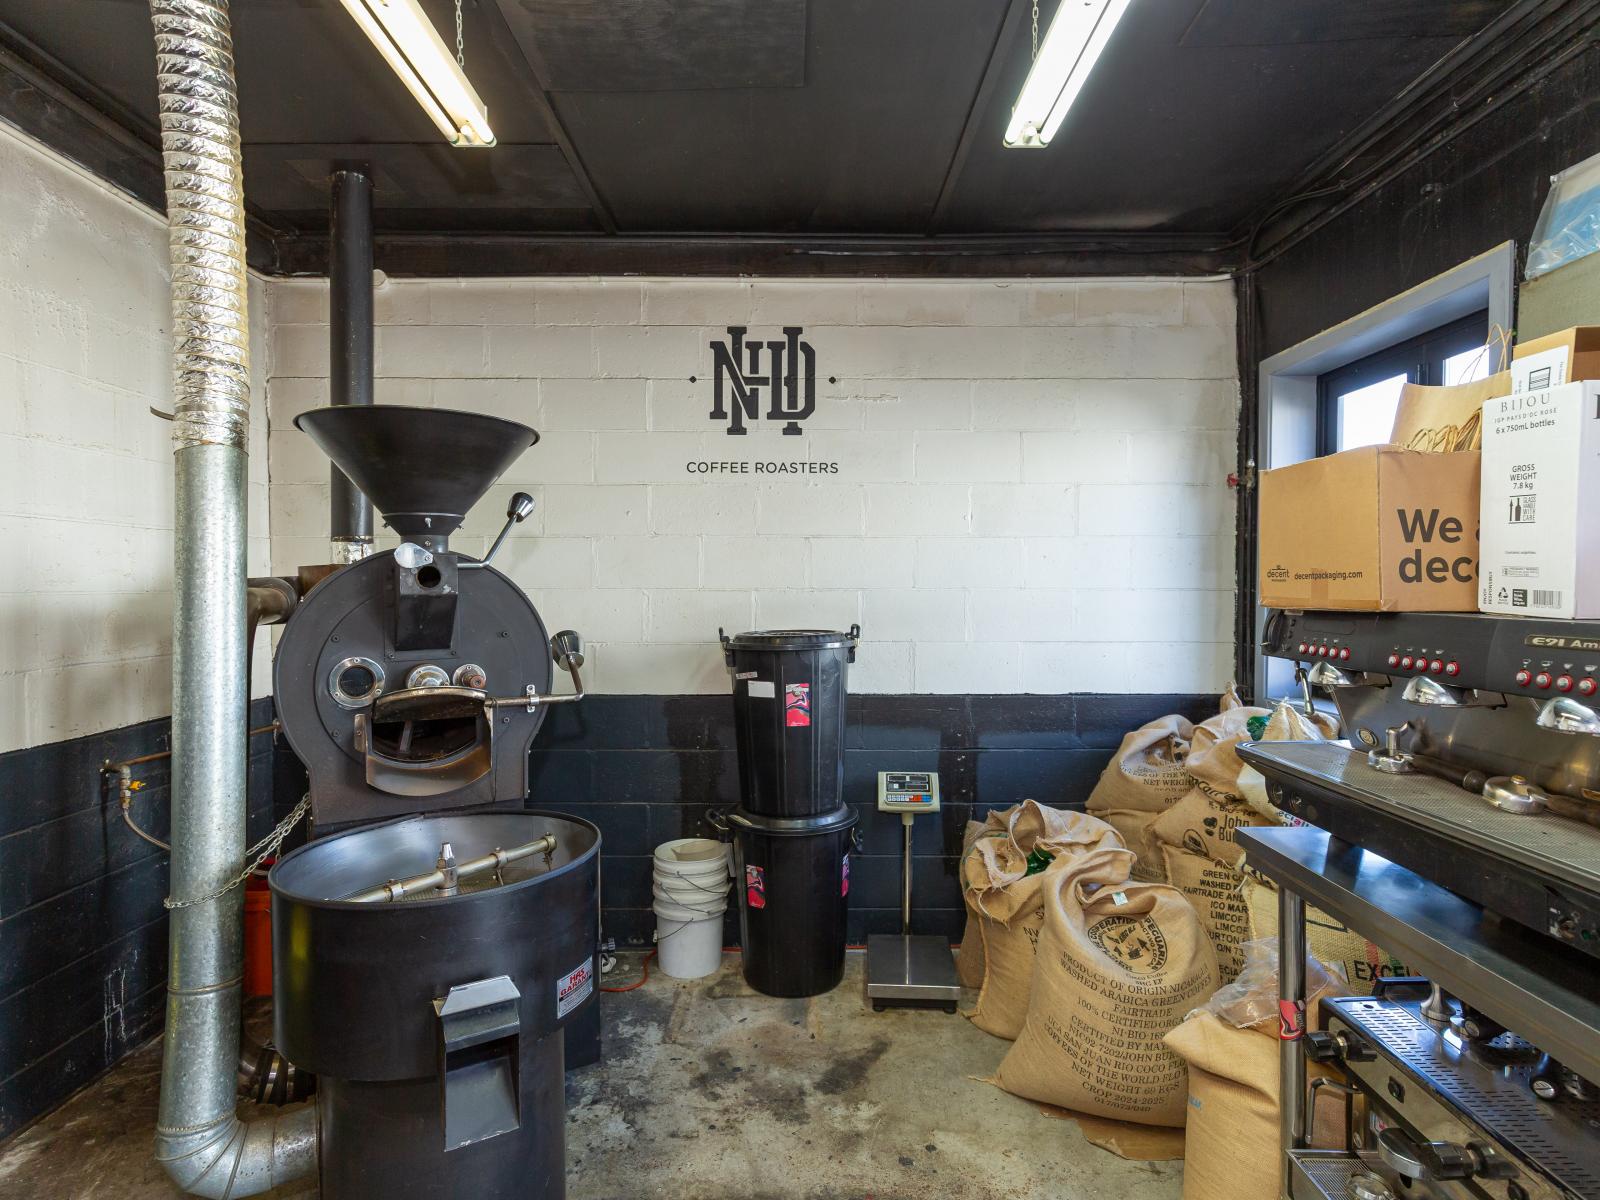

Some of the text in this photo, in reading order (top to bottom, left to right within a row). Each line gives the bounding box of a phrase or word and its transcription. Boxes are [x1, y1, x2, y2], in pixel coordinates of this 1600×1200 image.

[1501, 392, 1550, 413] BIJOU
[1495, 426, 1501, 434] 6
[1506, 422, 1528, 433] 750mL
[1530, 419, 1555, 429] bottles
[686, 461, 839, 474] COFFEE ROASTERS
[1512, 463, 1535, 473] GROSS
[1510, 471, 1537, 481] WEIGHT
[1513, 481, 1534, 491] 7.8 kg
[1396, 508, 1464, 543] We
[1266, 568, 1290, 578] decent
[1398, 548, 1480, 584] dec
[1294, 570, 1363, 581] decentpackaging.com
[1570, 639, 1600, 649] Am
[1143, 778, 1160, 786] NET
[1223, 814, 1250, 830] John
[1202, 869, 1230, 881] GREEN
[1200, 879, 1232, 891] WASHED
[1183, 886, 1224, 900] FAIRTRADE
[1210, 901, 1225, 910] ICO
[1210, 910, 1244, 922] LIMCOF
[1207, 930, 1240, 945] URTON
[1063, 951, 1108, 985] PRODUCT
[1110, 979, 1125, 991] OF
[1128, 984, 1167, 996] ORIGIN
[1060, 958, 1098, 991] WASHED
[1100, 987, 1149, 1007] ARABICA
[1152, 993, 1186, 1007] GREEN
[1113, 1003, 1173, 1018] FAIRTRADE
[1101, 1011, 1158, 1029] CERTIFIED
[1072, 1015, 1168, 1051] CERTIFIED BY MAY
[1064, 1031, 1082, 1050] SAN
[1083, 1047, 1111, 1067] JUAN
[1114, 1060, 1133, 1072] RIO
[1136, 1063, 1165, 1074] COCO
[1072, 1060, 1094, 1080] NET
[1096, 1075, 1141, 1095] WEIGHT
[1080, 1056, 1094, 1068] OF
[1096, 1064, 1119, 1080] THE
[1121, 1072, 1160, 1085] WORLD
[1082, 1081, 1112, 1099] CROP
